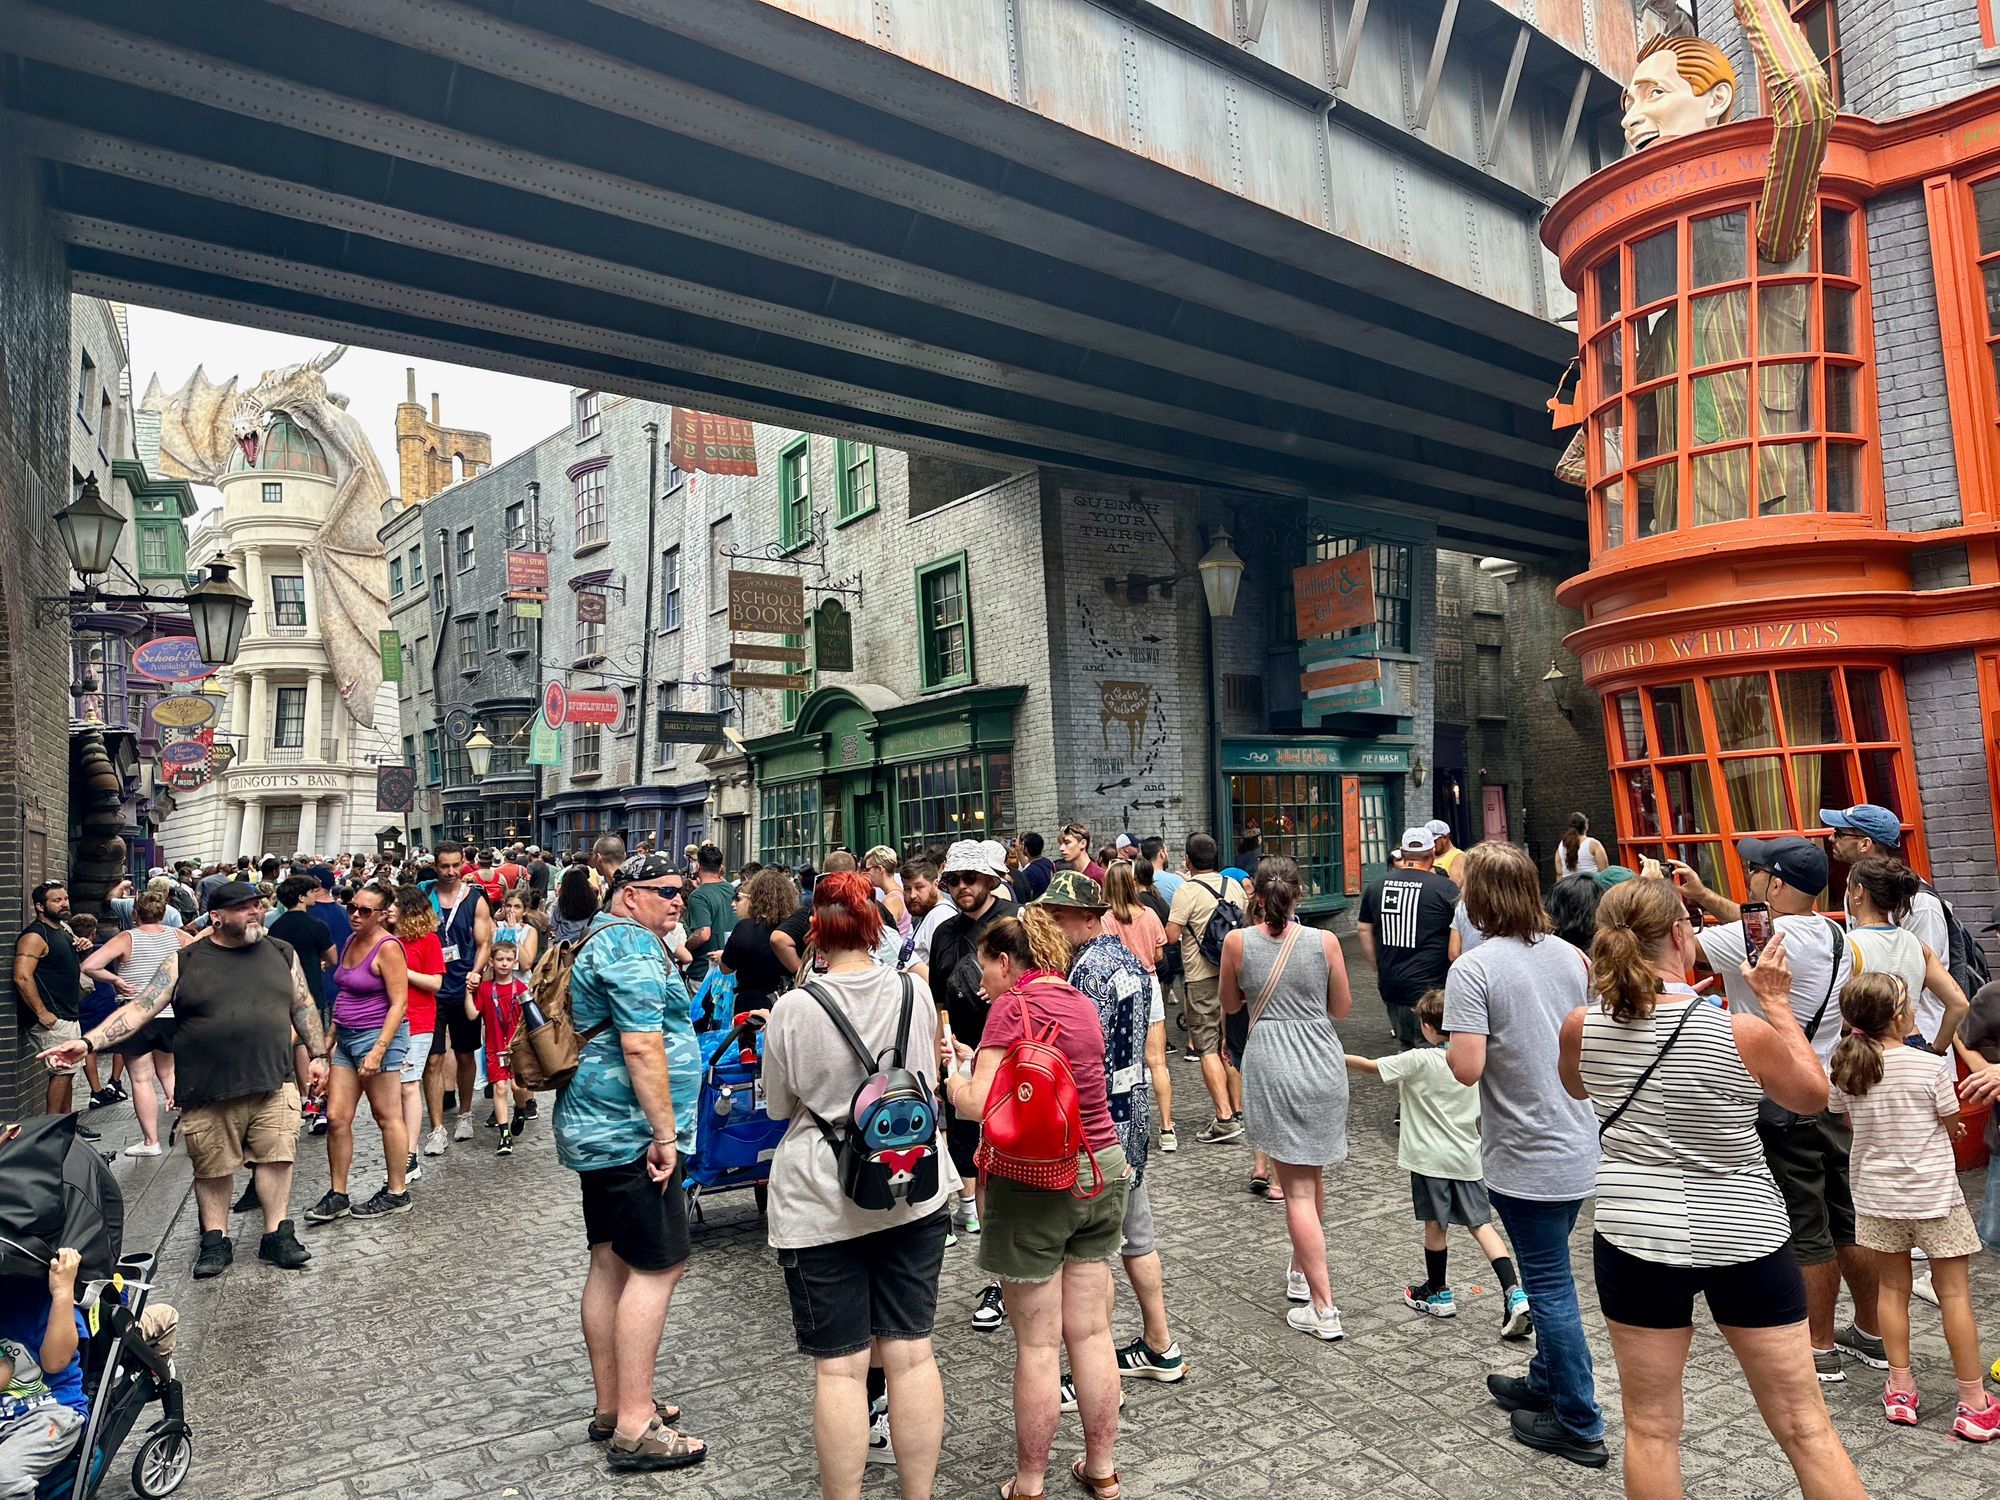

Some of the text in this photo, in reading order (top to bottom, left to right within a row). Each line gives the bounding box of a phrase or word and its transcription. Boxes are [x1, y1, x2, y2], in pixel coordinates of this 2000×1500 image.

[1624, 160, 1727, 207] MAGICAL
[1738, 151, 1771, 171] MA
[685, 422, 752, 438] SPELL
[685, 443, 755, 460] BOOKS
[1073, 495, 1160, 515] QUENCH
[1088, 511, 1148, 527] YOUR
[1080, 525, 1157, 542] THIRST
[732, 589, 801, 608] SCHOOL
[732, 604, 802, 625] BOOKS
[773, 624, 790, 632] HERE
[138, 649, 180, 663] School
[1128, 647, 1160, 664] THIS WAY
[1583, 620, 1840, 676] WIZARD WHEEZES
[150, 662, 188, 671] Available
[1082, 663, 1105, 672] and
[166, 699, 197, 710] Perfect
[664, 722, 717, 732] DAILY PROPHET
[1093, 758, 1125, 775] THIS WAY
[1361, 754, 1373, 764] PIE
[1379, 754, 1400, 764] MASH
[230, 774, 337, 790] GRINGOTTS BANK
[1143, 782, 1166, 792] and
[1383, 879, 1423, 889] FREEDOM
